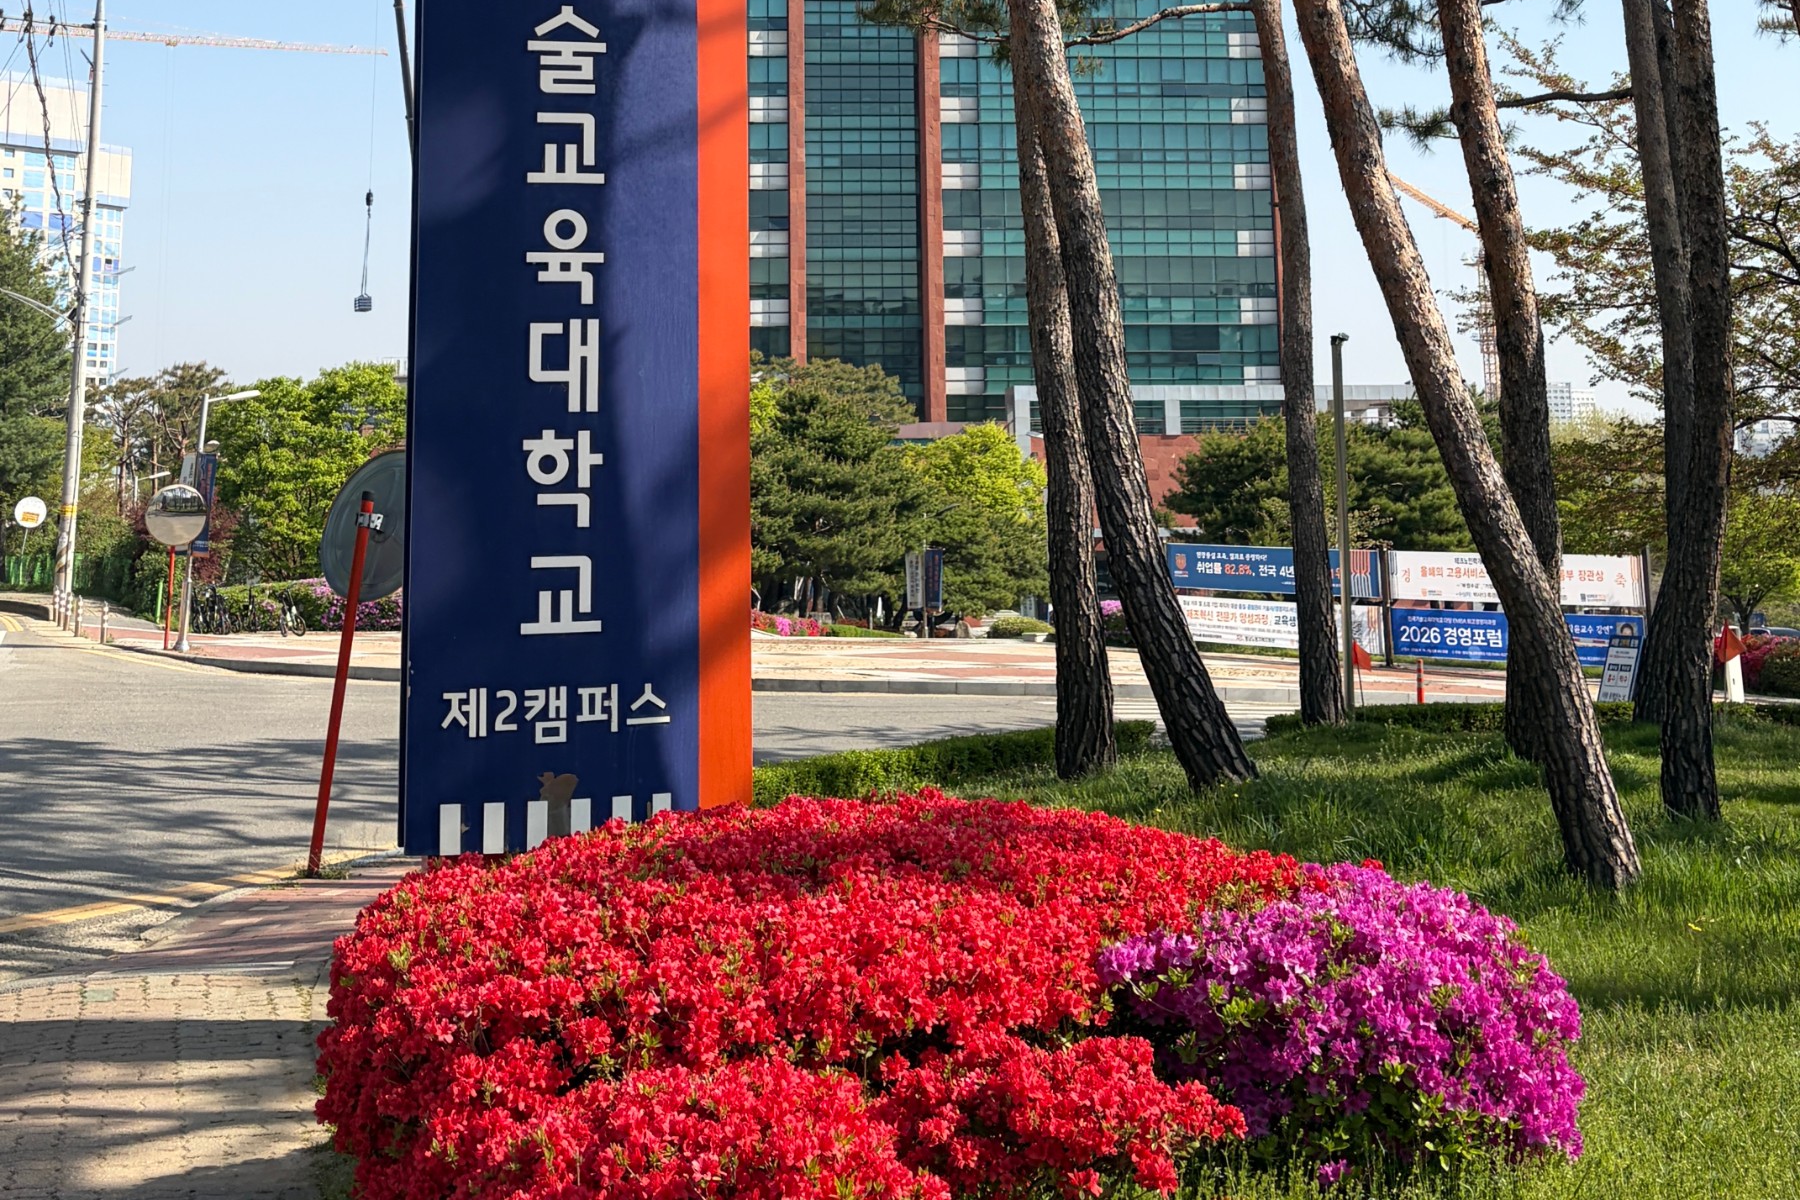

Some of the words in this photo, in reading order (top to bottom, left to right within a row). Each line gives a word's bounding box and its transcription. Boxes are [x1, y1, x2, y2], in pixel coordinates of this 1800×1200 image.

[1196, 561, 1222, 574] 취업률
[1258, 564, 1277, 577] 전국
[1420, 565, 1444, 578] 올해의
[1446, 566, 1486, 579] 고용서비스
[1578, 569, 1604, 582] 장관상
[1216, 611, 1238, 623] 전문가
[1400, 625, 1441, 644] 2026
[1443, 627, 1503, 648] 경영포럼
[441, 683, 671, 744] 제2캠퍼스
